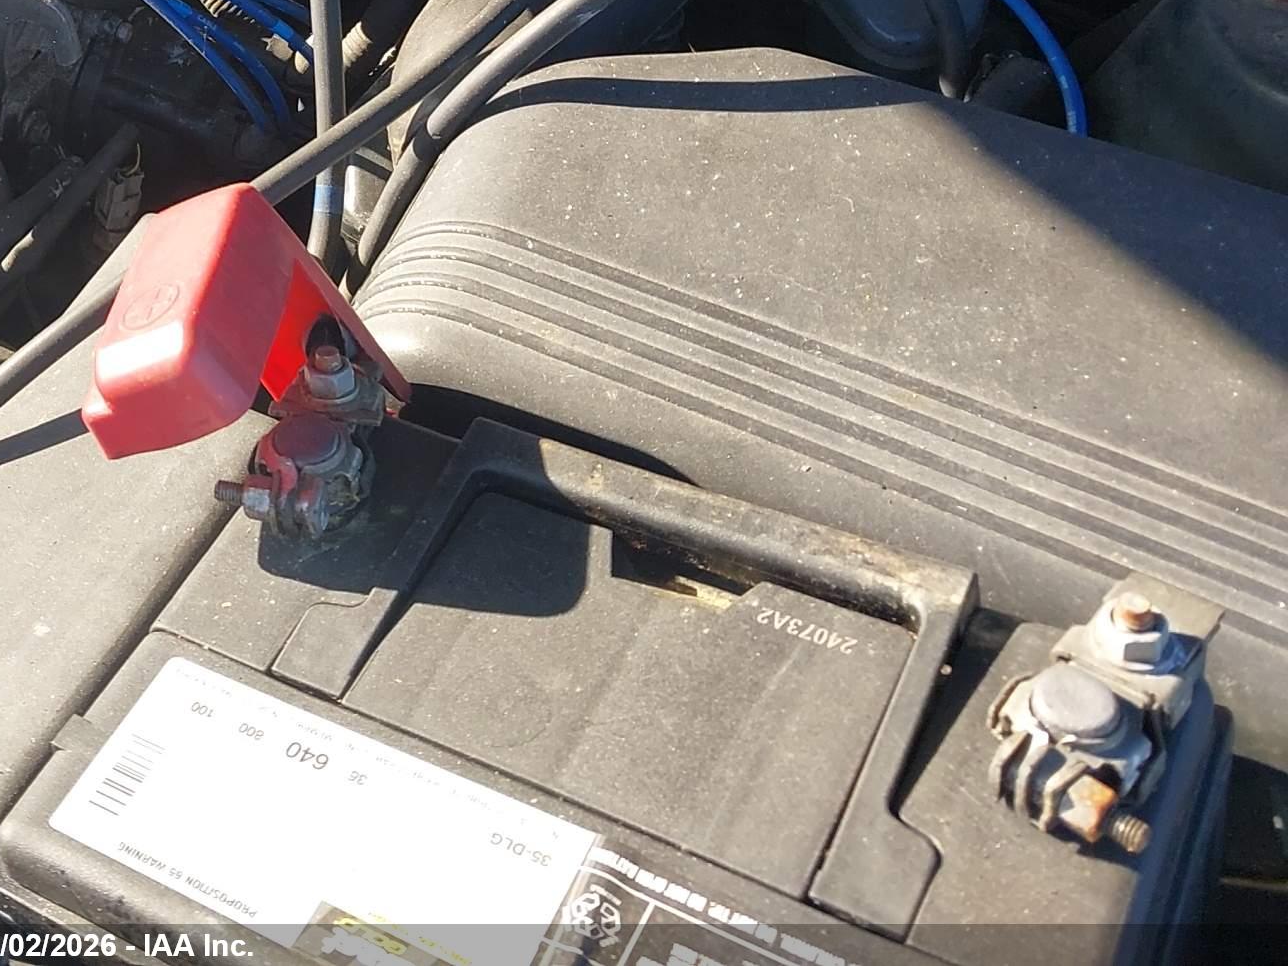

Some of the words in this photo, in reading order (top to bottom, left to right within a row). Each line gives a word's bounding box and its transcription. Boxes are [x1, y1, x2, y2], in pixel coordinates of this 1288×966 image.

[756, 607, 858, 654] 24073A2
[191, 701, 214, 718] 100
[285, 741, 330, 770] 640
[118, 841, 167, 871] WARNING
[490, 832, 552, 867] 35-DLG
[185, 876, 258, 919] PROPOSITION
